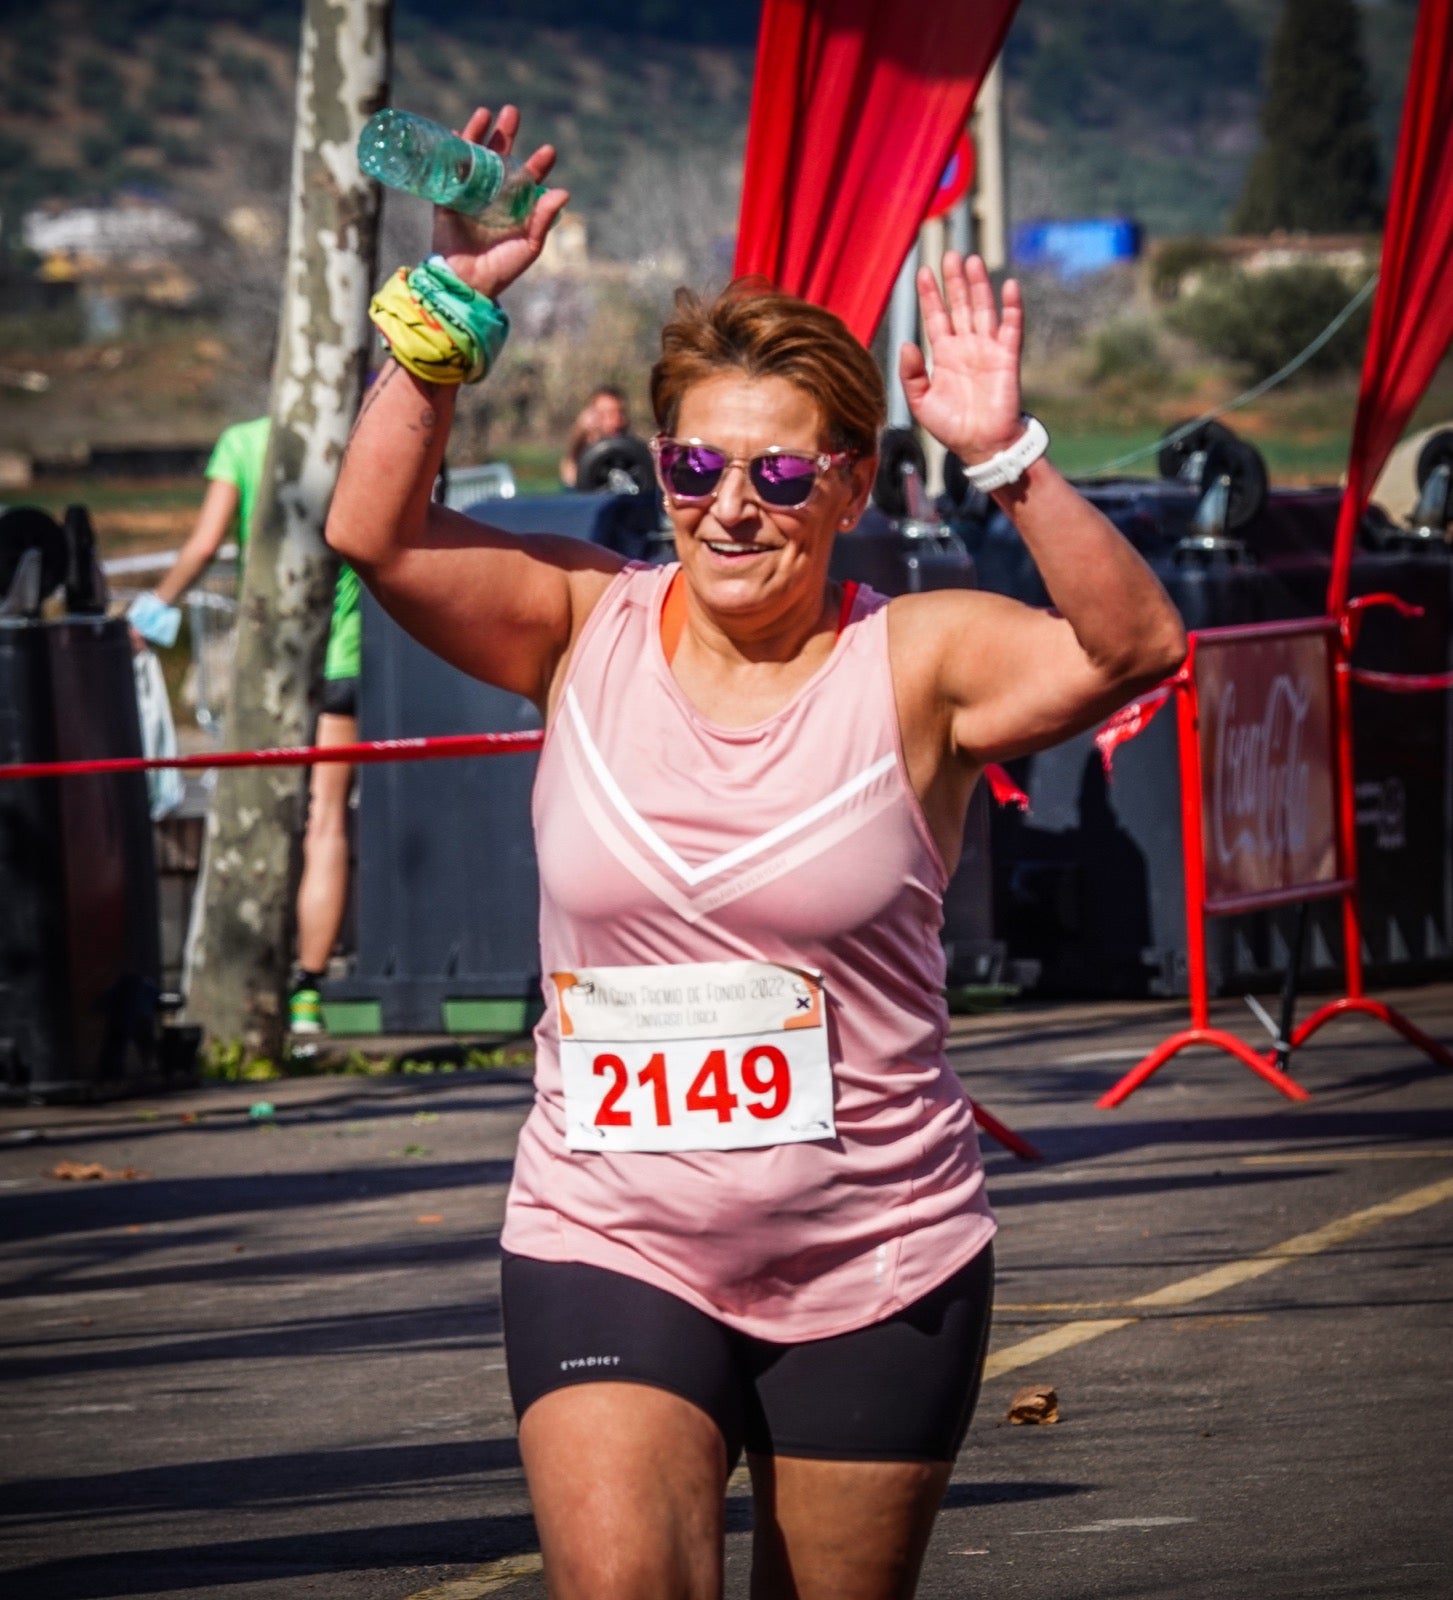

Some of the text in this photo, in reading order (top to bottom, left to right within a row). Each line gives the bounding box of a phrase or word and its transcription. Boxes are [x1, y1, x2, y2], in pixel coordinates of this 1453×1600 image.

[706, 980, 746, 1003] FONDO
[750, 976, 785, 999] 2022
[592, 1045, 792, 1127] 2149
[560, 1355, 621, 1371] EVADICT
